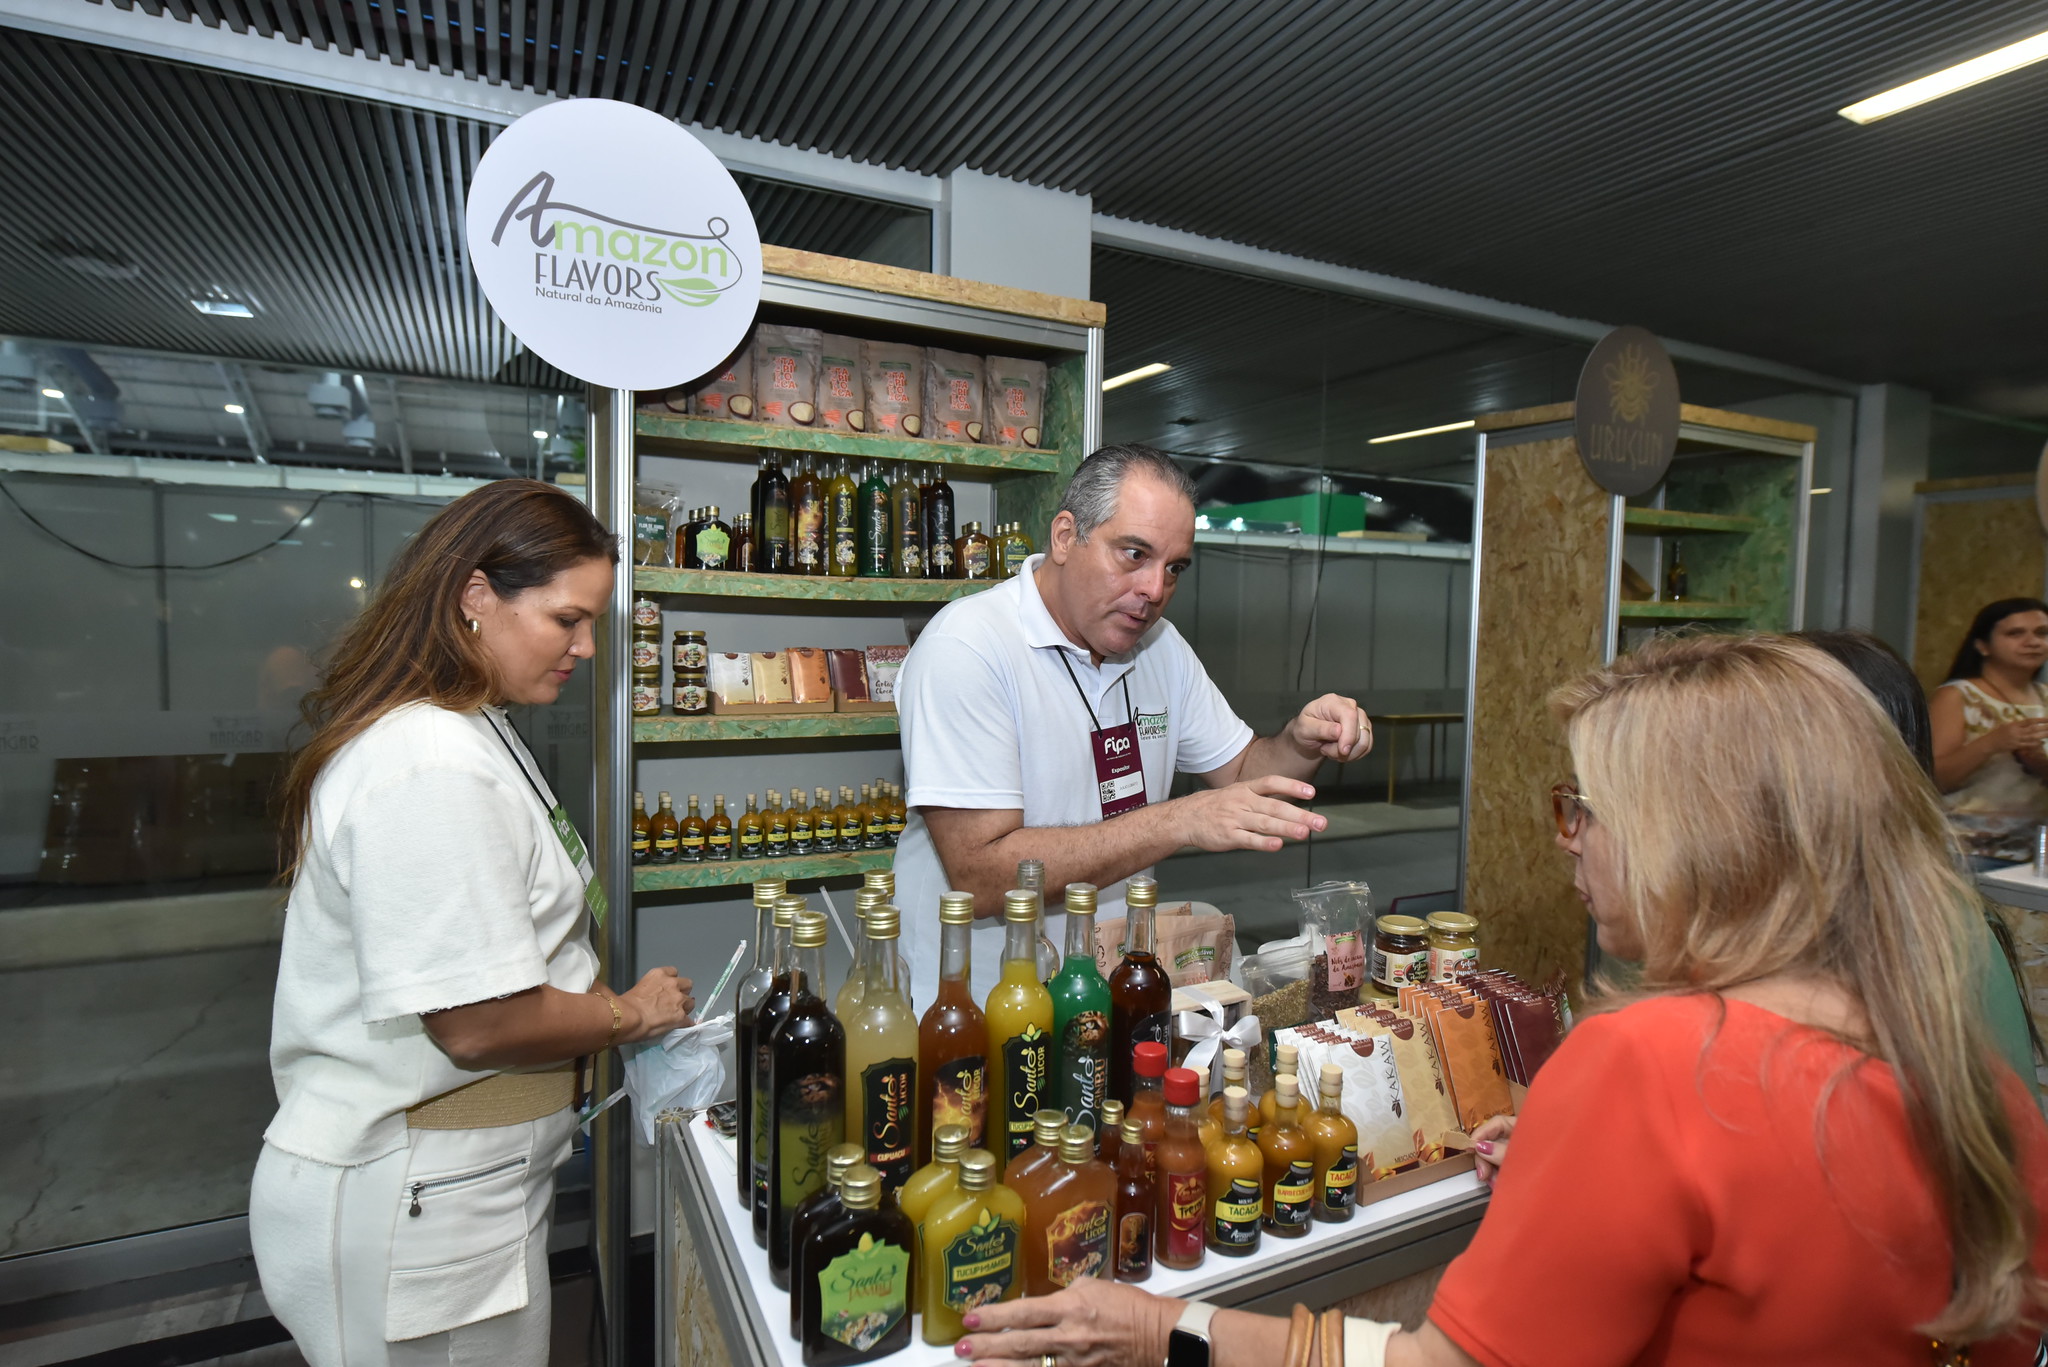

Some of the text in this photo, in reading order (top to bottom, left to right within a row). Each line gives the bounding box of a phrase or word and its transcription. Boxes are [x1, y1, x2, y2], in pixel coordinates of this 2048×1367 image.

[491, 170, 742, 283] Amazon
[535, 252, 661, 301] FLAVORS
[535, 286, 663, 314] Natural da Amazônia
[1037, 1045, 1045, 1076] LICOR
[1377, 1040, 1402, 1102] KAKAW
[1417, 1022, 1440, 1082] KAKAW
